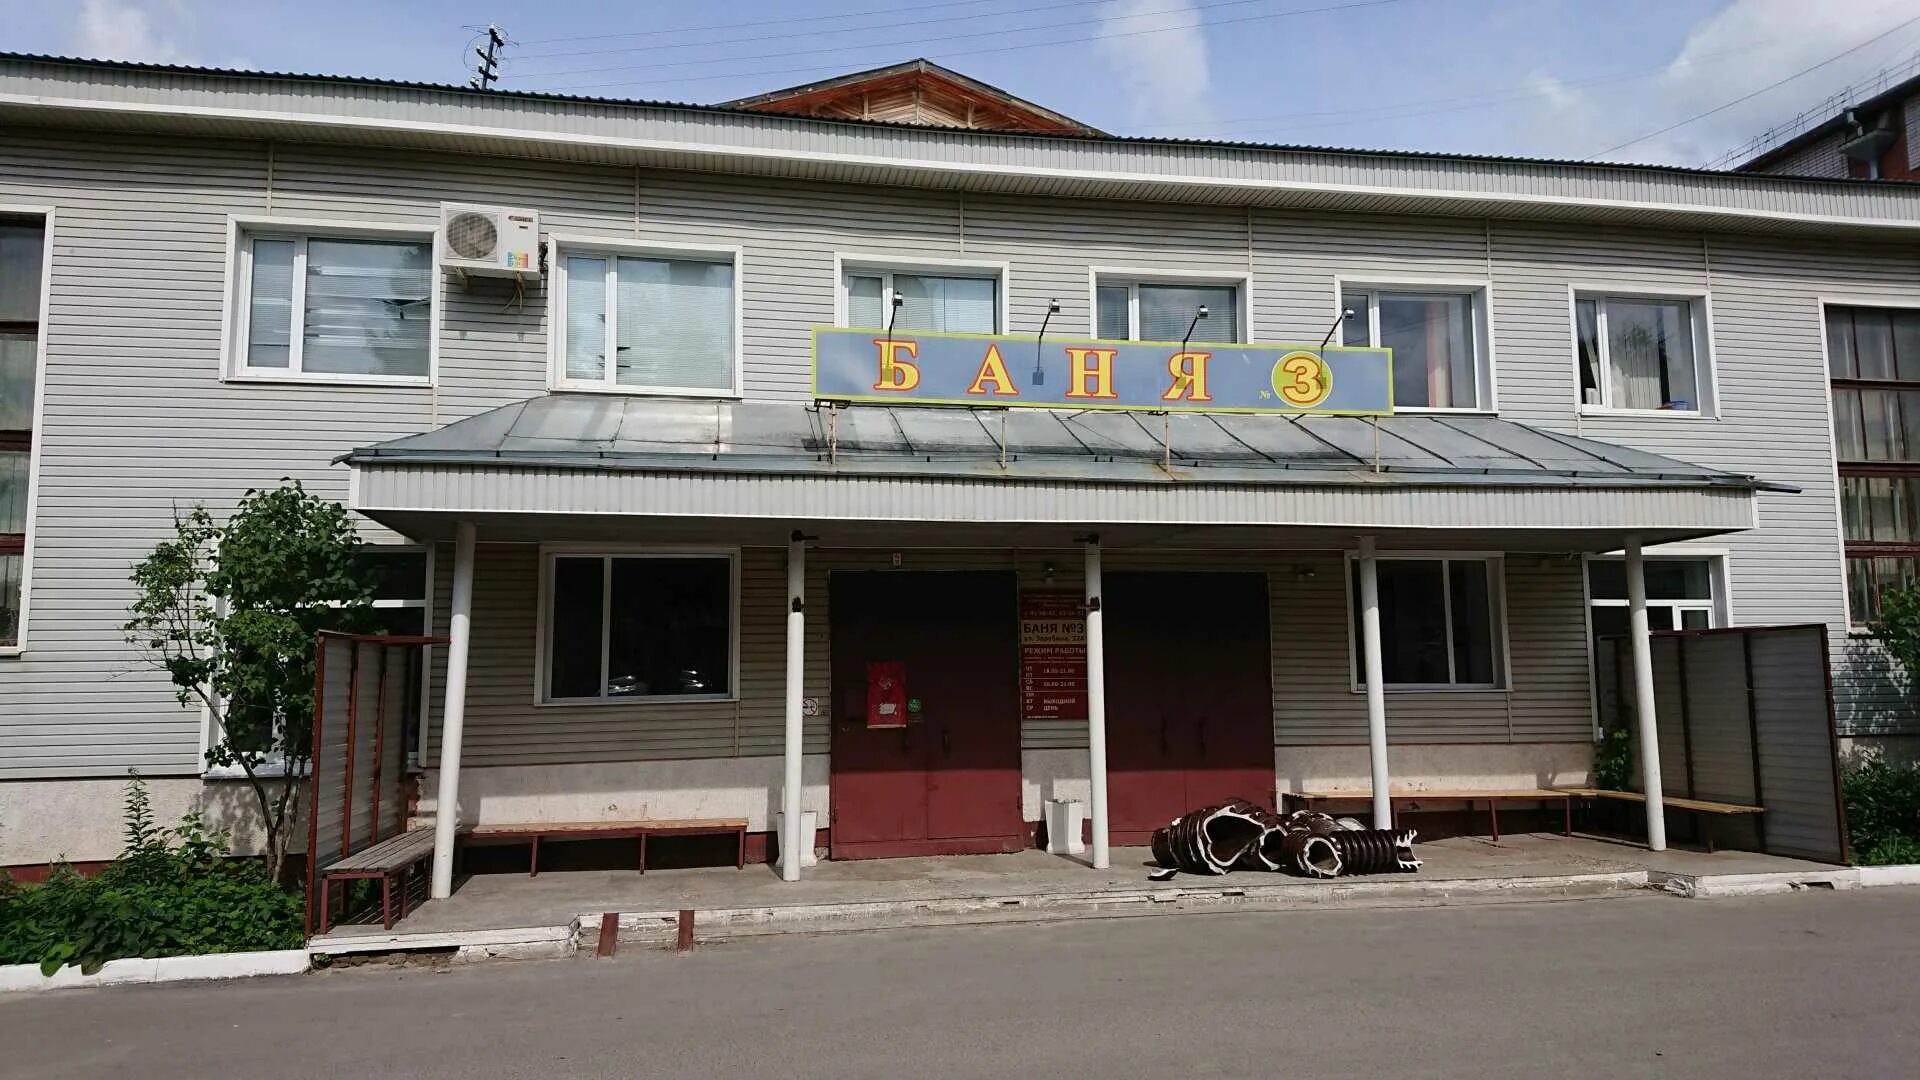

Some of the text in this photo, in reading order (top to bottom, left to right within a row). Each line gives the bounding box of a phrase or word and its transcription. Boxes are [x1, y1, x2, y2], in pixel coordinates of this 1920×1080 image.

[873, 339, 1211, 401] БАНЯ
[1282, 356, 1323, 403] 3
[1023, 623, 1084, 633] БАНЯ №3
[1024, 647, 1053, 655] РЕЖИМ
